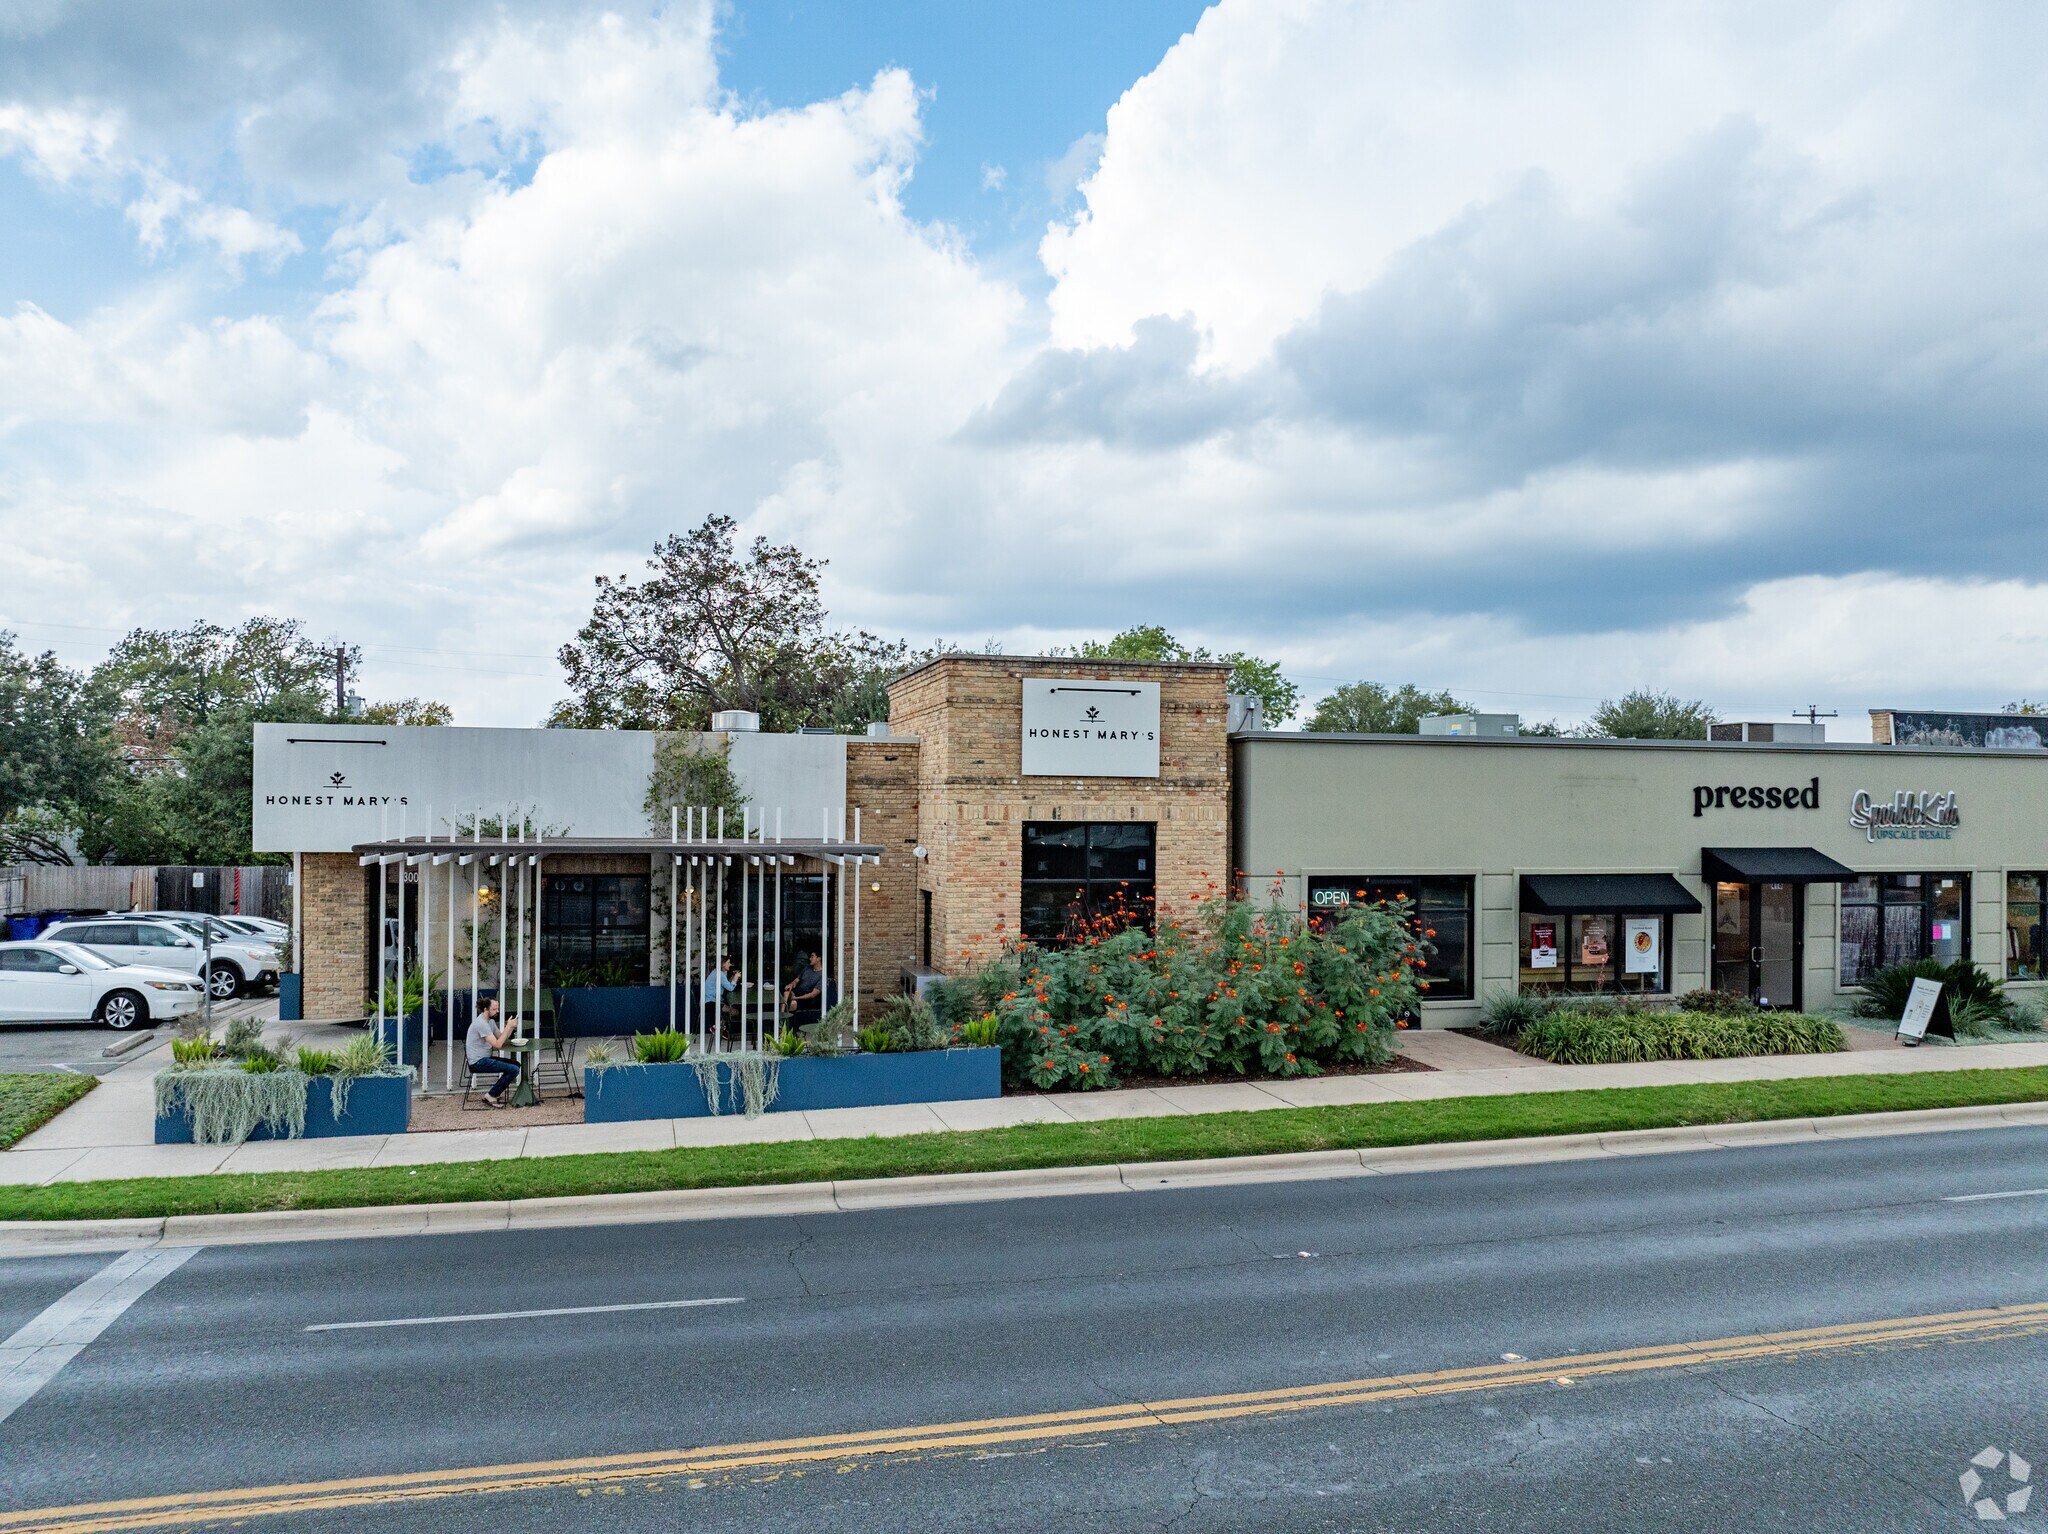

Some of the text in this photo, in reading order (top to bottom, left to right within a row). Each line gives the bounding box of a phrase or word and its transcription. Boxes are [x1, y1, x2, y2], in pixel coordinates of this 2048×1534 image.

[1029, 729, 1154, 741] HONEST MARY'S
[266, 796, 408, 806] HONEST MARY'S
[1693, 777, 1820, 817] pressed
[1876, 829, 1952, 840] UPSCALE RESALE
[404, 872, 419, 883] 300
[1315, 891, 1350, 905] OPEN
